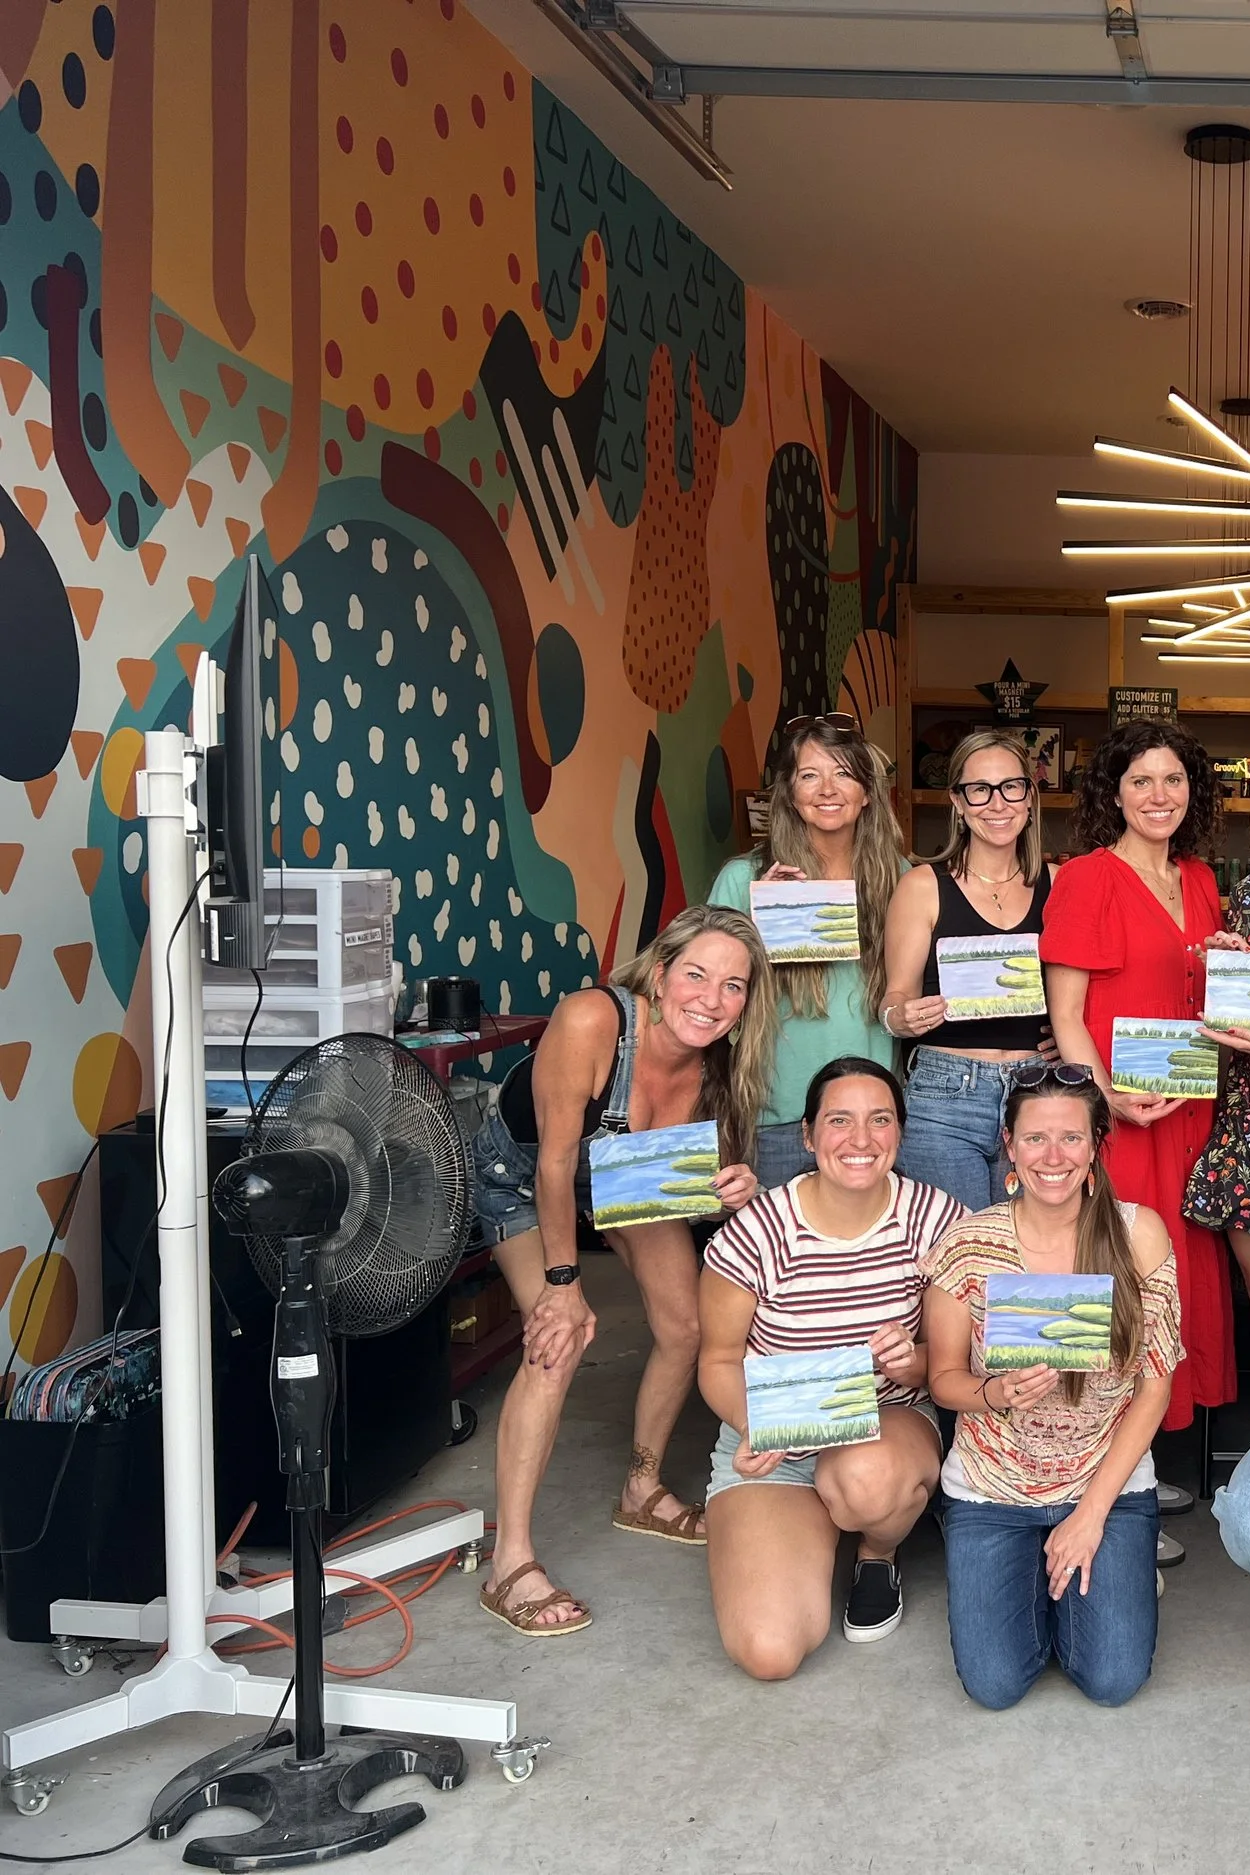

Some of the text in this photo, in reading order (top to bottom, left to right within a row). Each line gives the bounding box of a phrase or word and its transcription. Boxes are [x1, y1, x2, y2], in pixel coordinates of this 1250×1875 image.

[994, 681, 1010, 689] POUR
[1011, 681, 1016, 689] A
[1115, 690, 1172, 703] CUSTOMIZE IT!
[1004, 696, 1021, 709] $15
[1116, 704, 1131, 713] ADD
[1132, 704, 1159, 714] GLITTER
